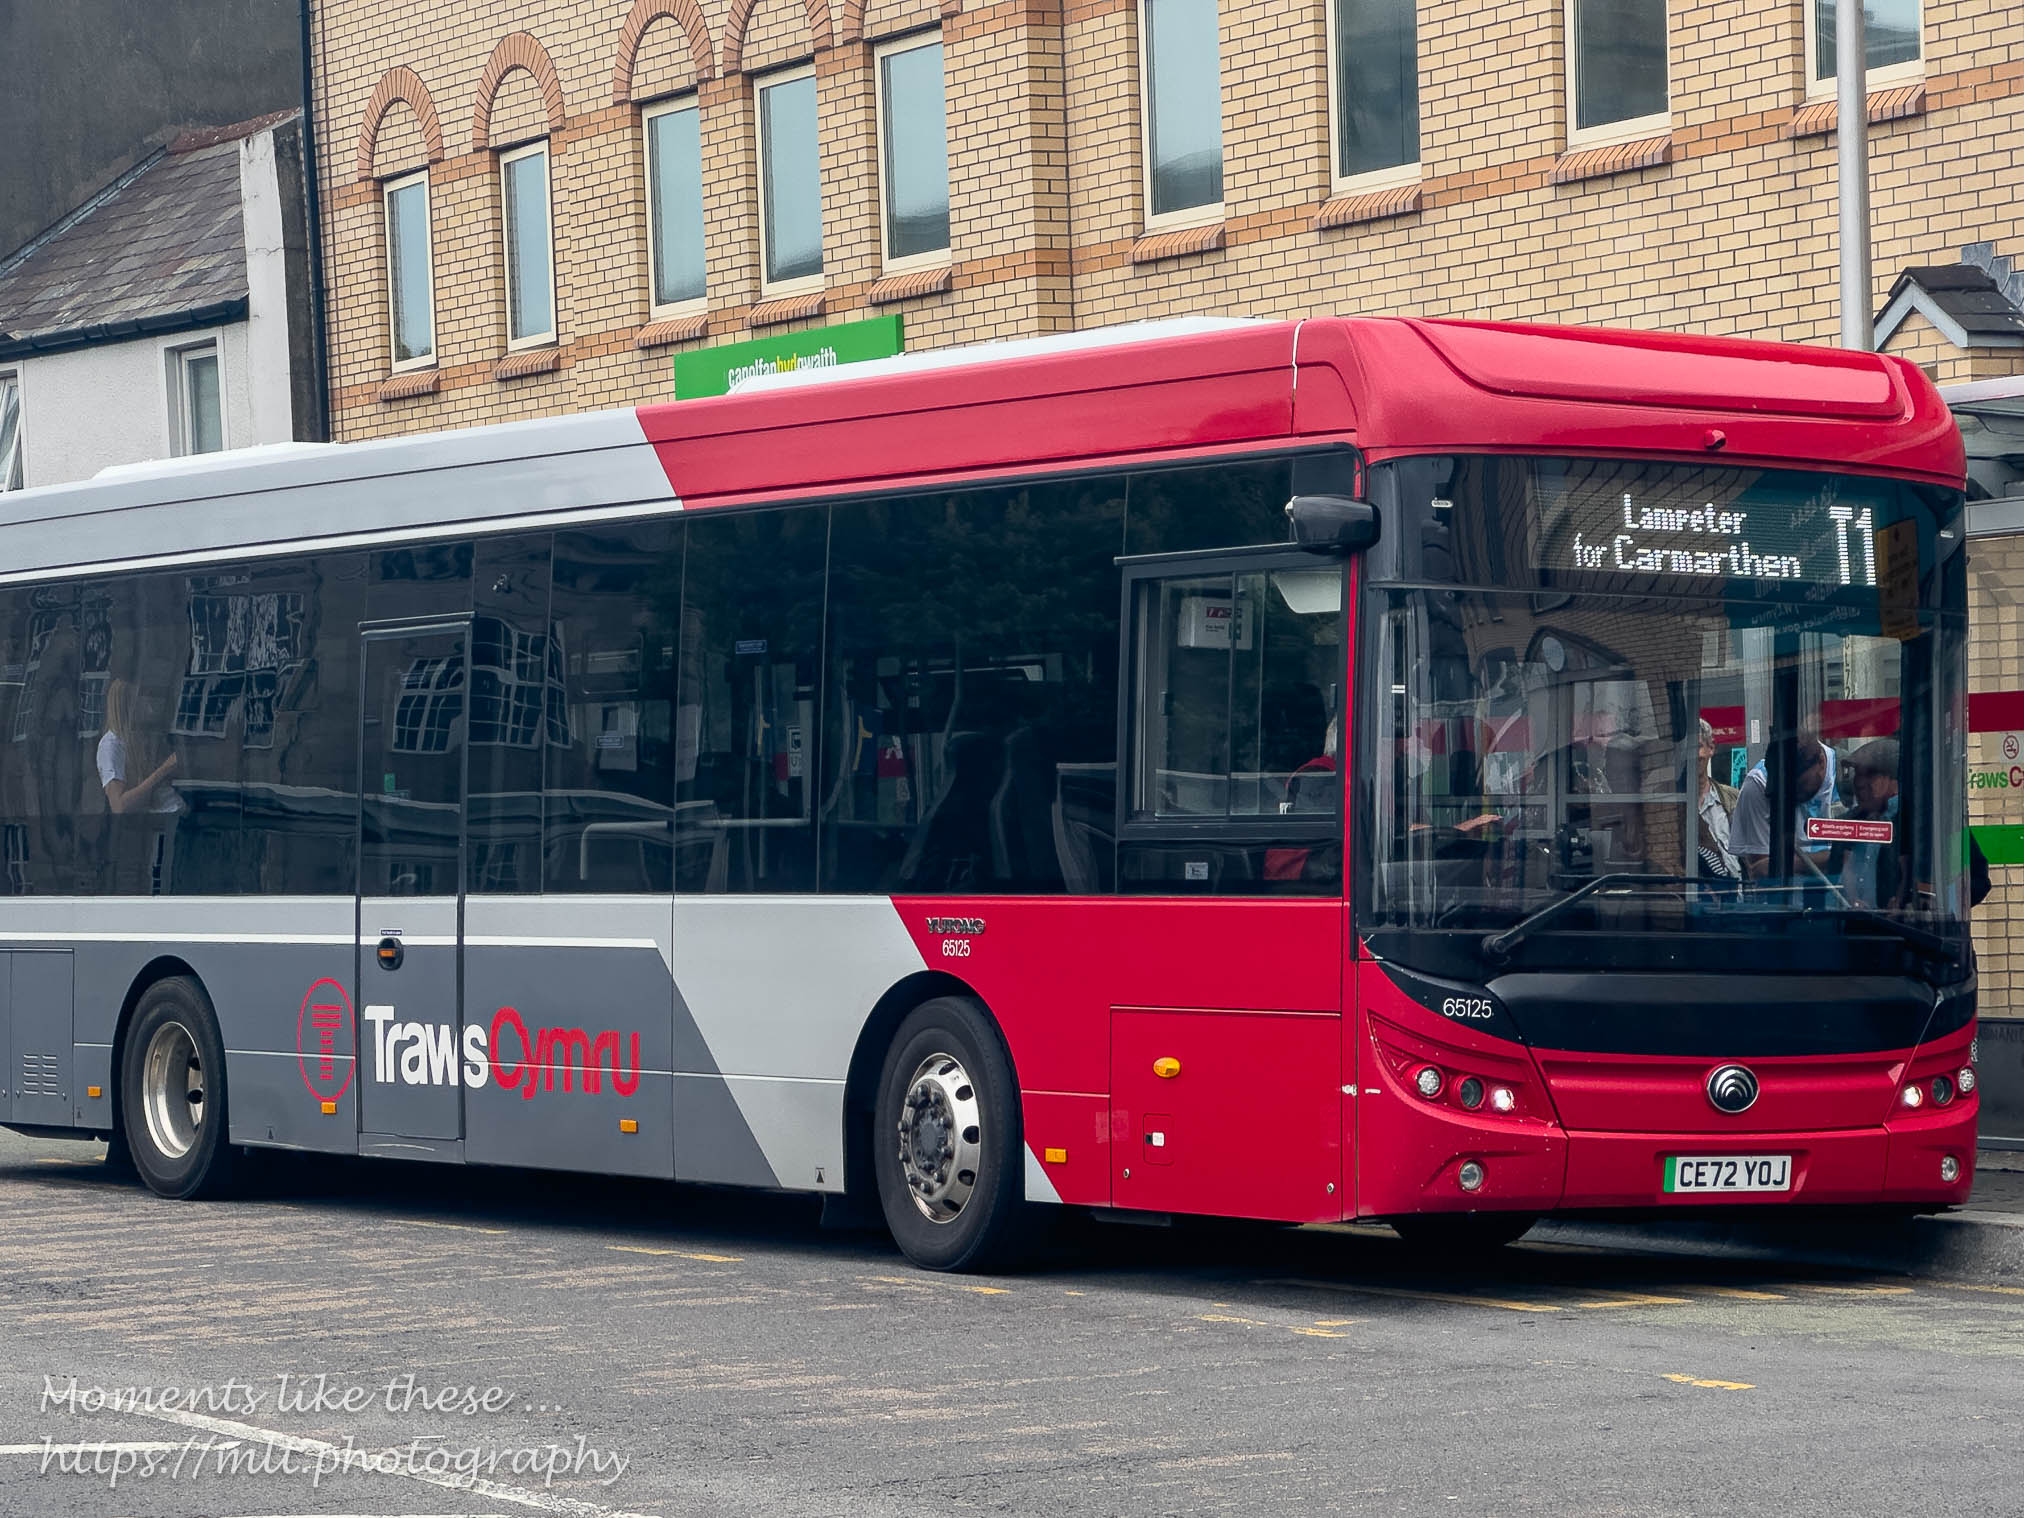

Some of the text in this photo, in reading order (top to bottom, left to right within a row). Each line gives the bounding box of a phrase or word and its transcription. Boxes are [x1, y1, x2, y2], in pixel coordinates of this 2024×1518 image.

[1623, 494, 1747, 534] Lampeter
[1573, 533, 1801, 578] for Carmarthen
[1829, 505, 1876, 585] T1
[1968, 766, 2024, 789] rawsC
[926, 917, 986, 934] YUTONG
[942, 939, 970, 956] 65125
[1443, 998, 1492, 1018] 65125
[364, 1005, 640, 1100] TrawsCymru
[1679, 1160, 1787, 1187] CE72 YOJ
